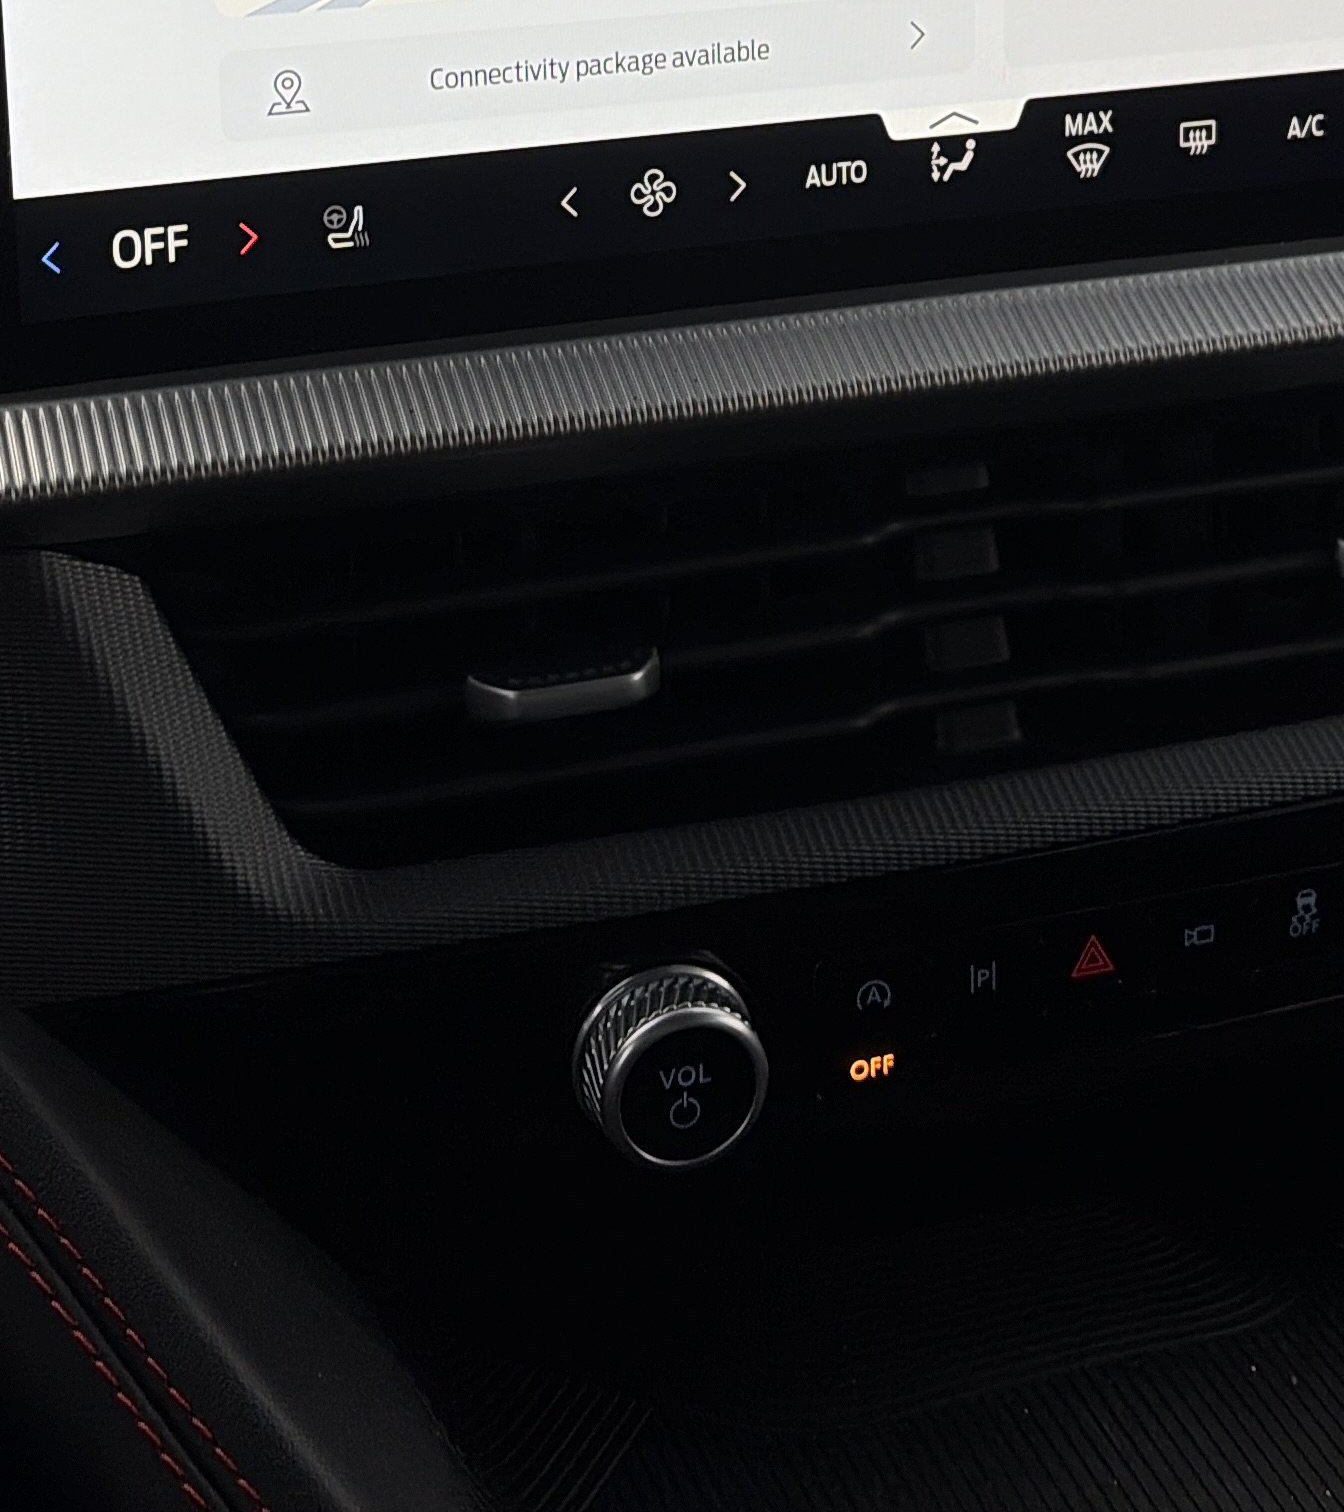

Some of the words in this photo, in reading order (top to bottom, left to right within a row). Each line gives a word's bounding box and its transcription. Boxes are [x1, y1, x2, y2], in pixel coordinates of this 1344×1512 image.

[430, 56, 569, 90] Connectivity
[576, 49, 666, 82] package
[671, 38, 770, 68] available
[1064, 111, 1113, 137] MAX
[1287, 114, 1325, 140] A/C
[805, 160, 868, 189] AUTO
[112, 224, 189, 269] OFF
[1289, 918, 1320, 938] OFF
[659, 1062, 712, 1091] VOL
[849, 1053, 895, 1082] OFF
